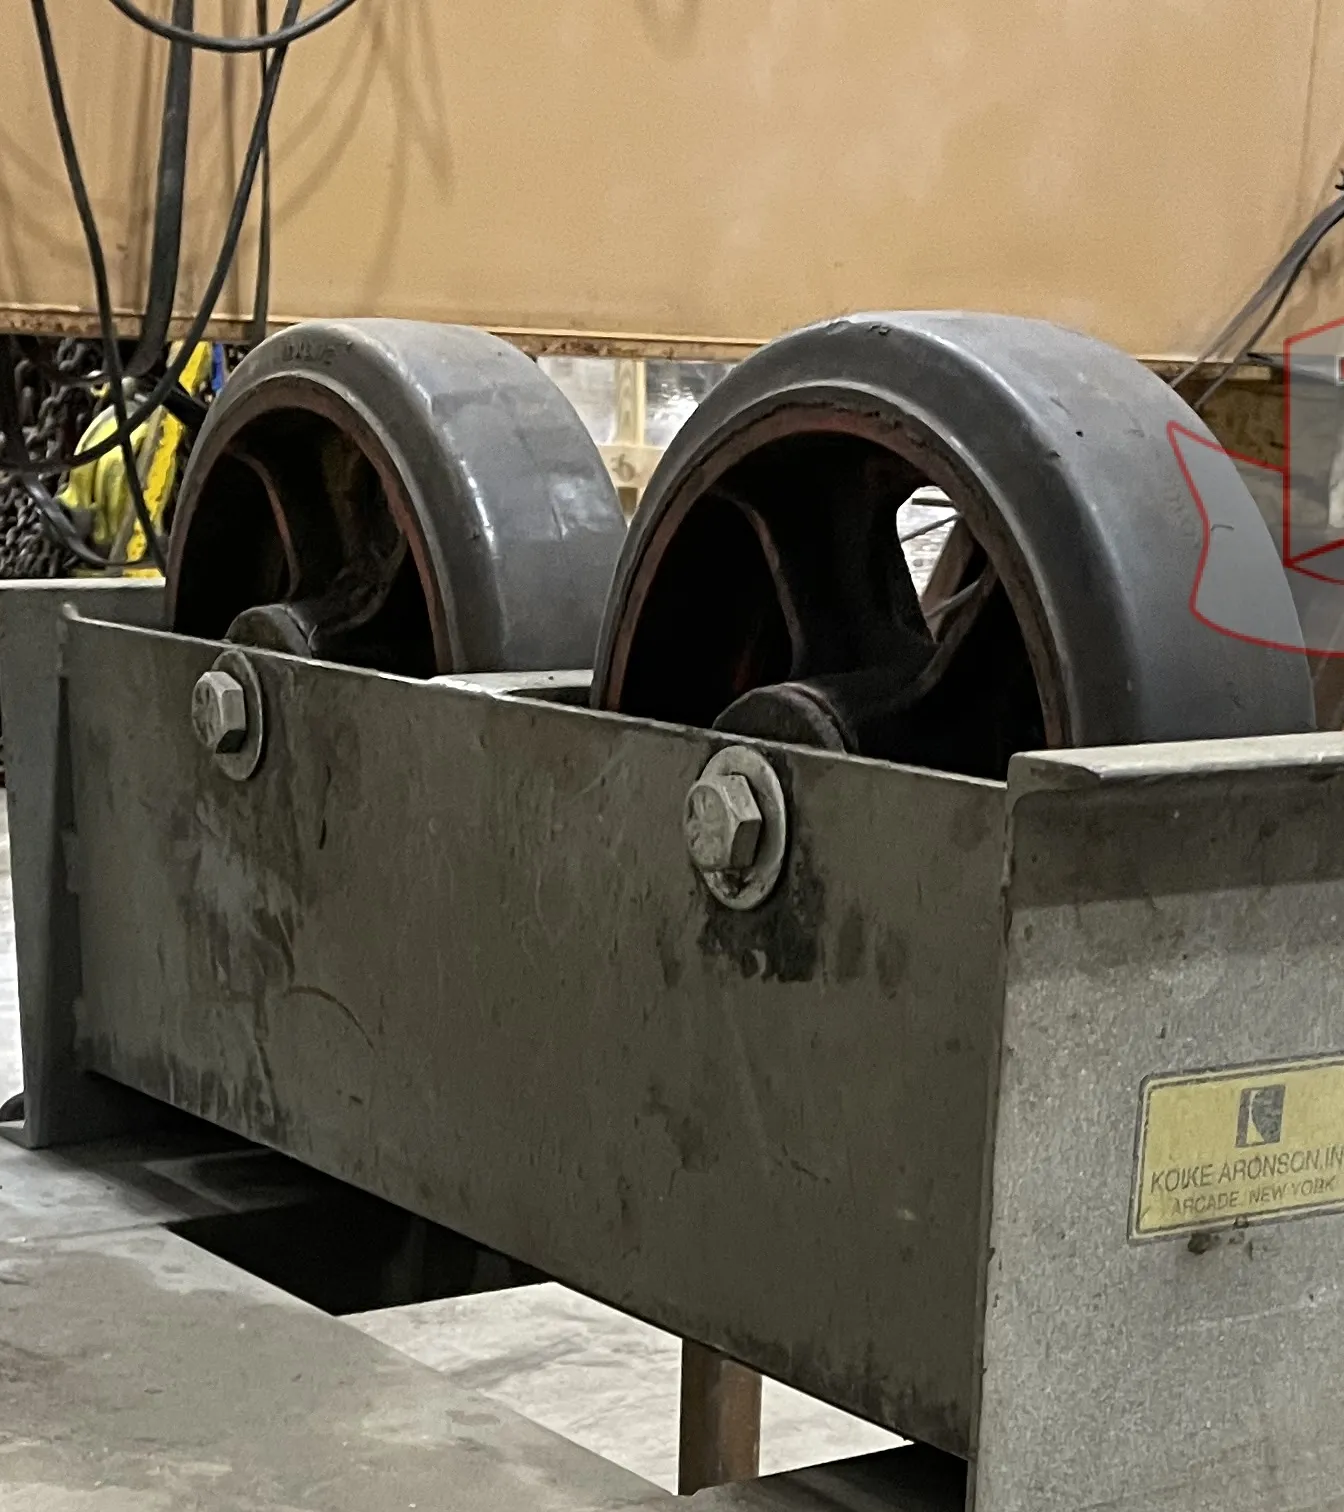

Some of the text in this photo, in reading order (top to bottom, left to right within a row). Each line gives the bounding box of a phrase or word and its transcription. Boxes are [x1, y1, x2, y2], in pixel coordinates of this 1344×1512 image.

[1151, 1163, 1213, 1194] KOIKE
[1248, 1182, 1287, 1204] NEW
[1291, 1175, 1337, 1197] YORK
